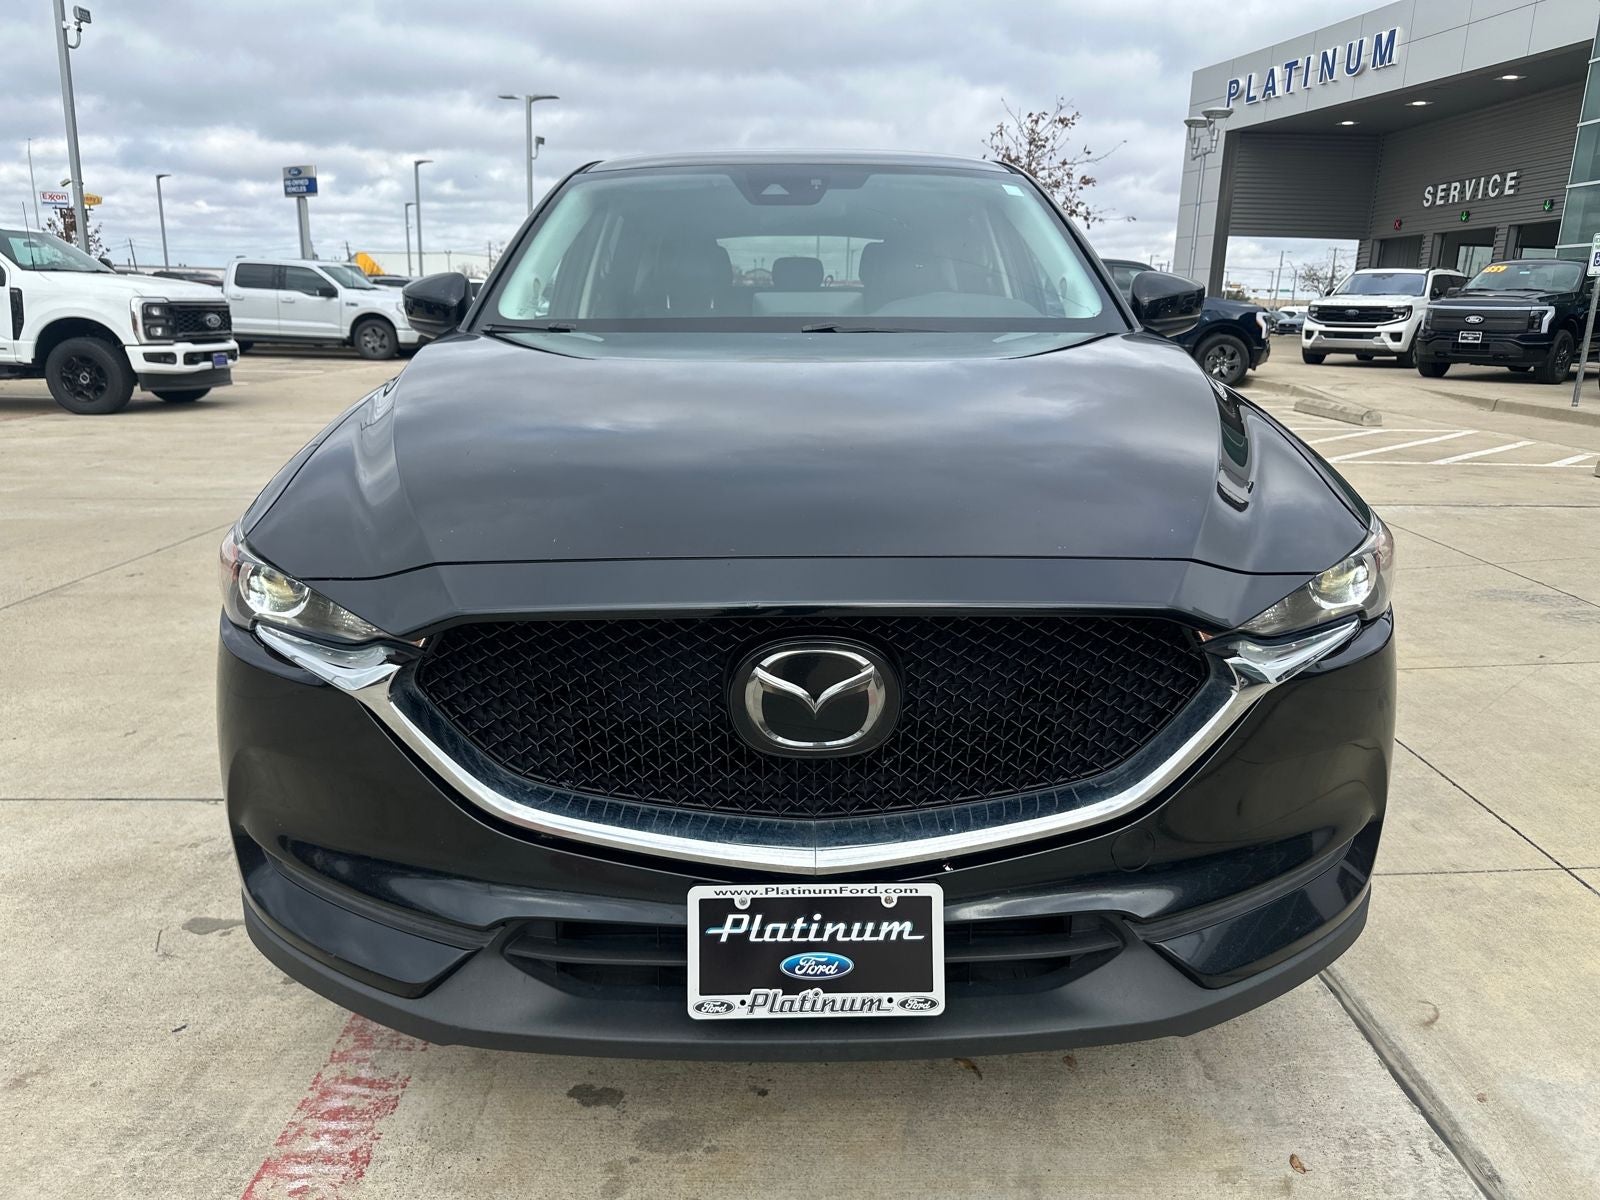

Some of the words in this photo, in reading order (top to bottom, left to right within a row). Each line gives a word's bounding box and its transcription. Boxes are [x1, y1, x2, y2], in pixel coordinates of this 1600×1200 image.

[1225, 26, 1400, 108] PLATINUM
[42, 192, 67, 201] Exxon
[1423, 171, 1518, 208] SERVICE
[714, 885, 919, 897] www.PlatinumFord.com
[705, 913, 925, 943] Platinum
[794, 955, 840, 976] Ford
[699, 1001, 728, 1014] Ford
[742, 989, 893, 1015] Platinum
[904, 998, 932, 1010] Ford
